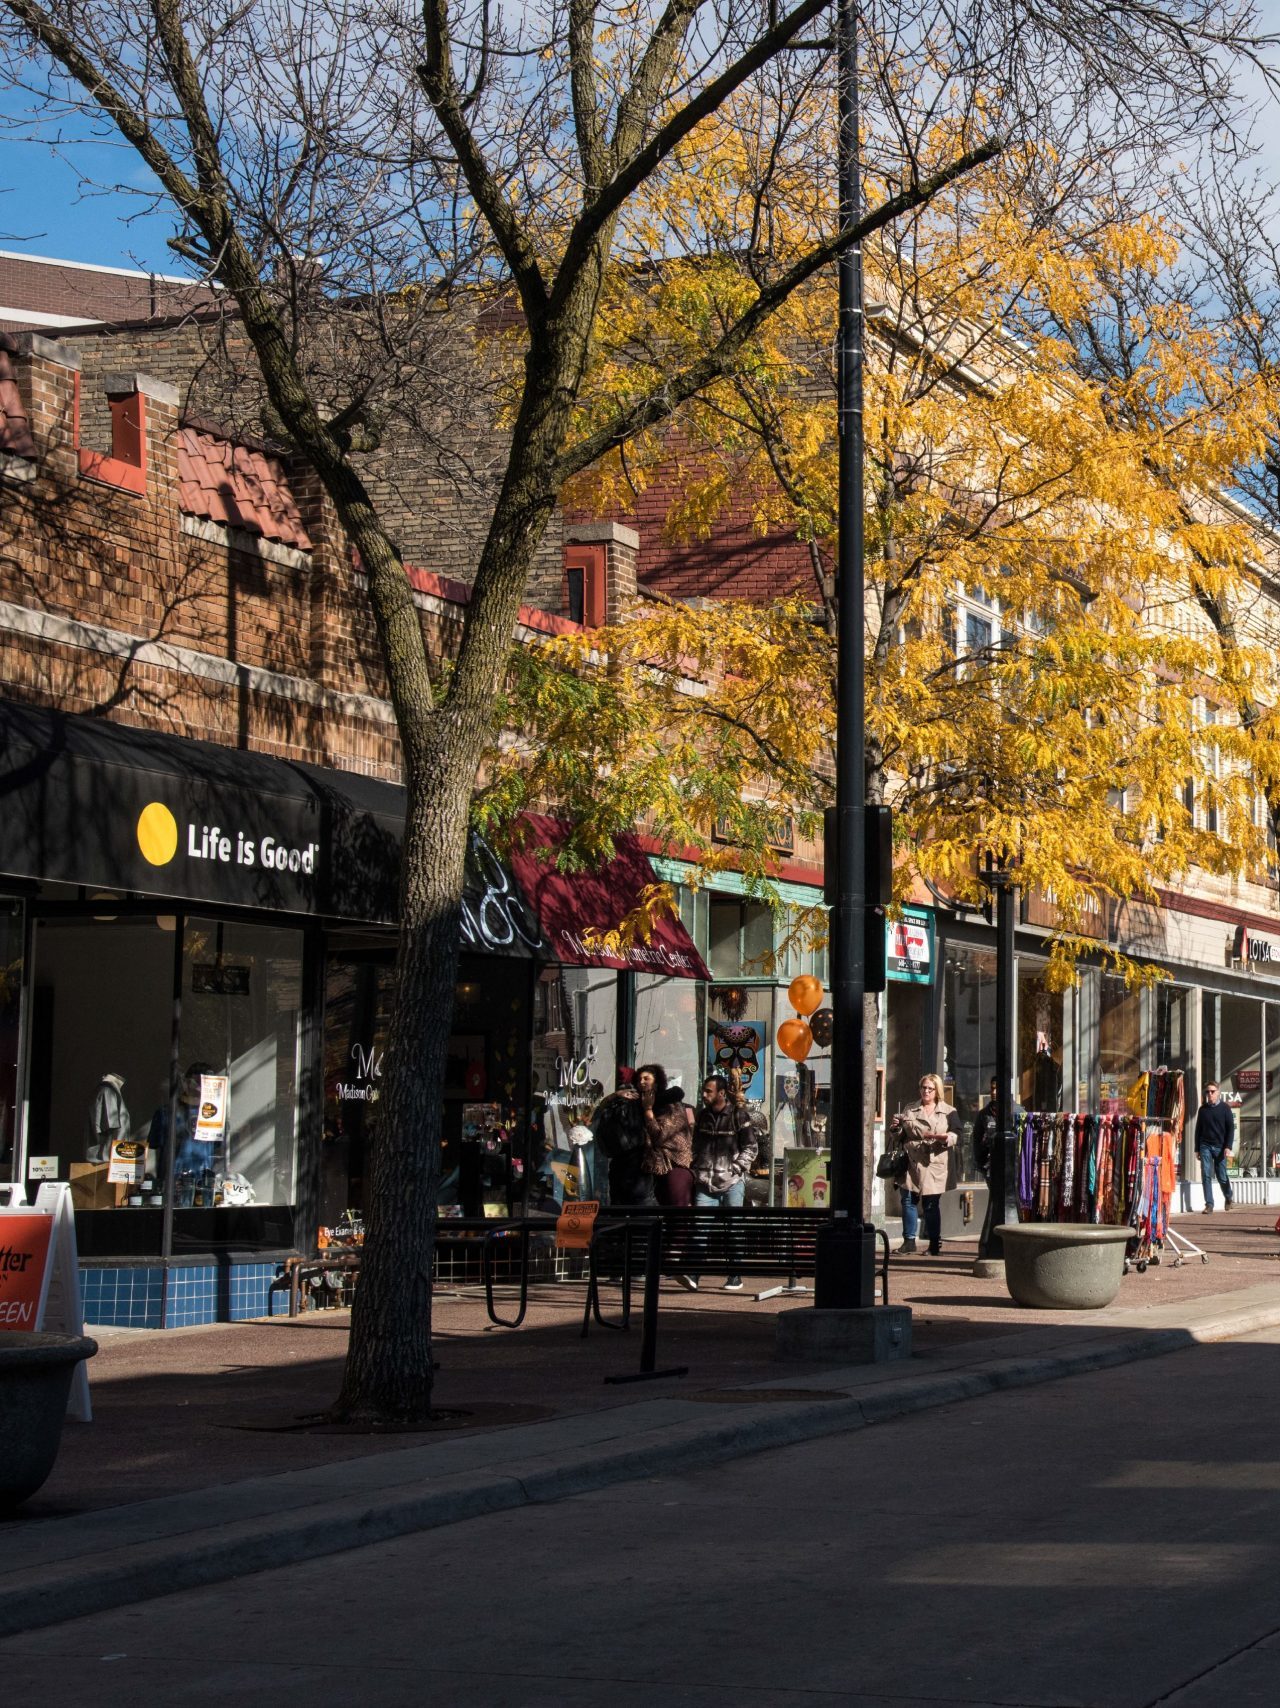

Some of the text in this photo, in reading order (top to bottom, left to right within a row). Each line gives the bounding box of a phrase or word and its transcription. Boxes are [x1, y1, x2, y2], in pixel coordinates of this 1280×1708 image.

[188, 823, 315, 875] Life is Good
[1249, 940, 1270, 962] LOTSA
[336, 1082, 365, 1101] Madison
